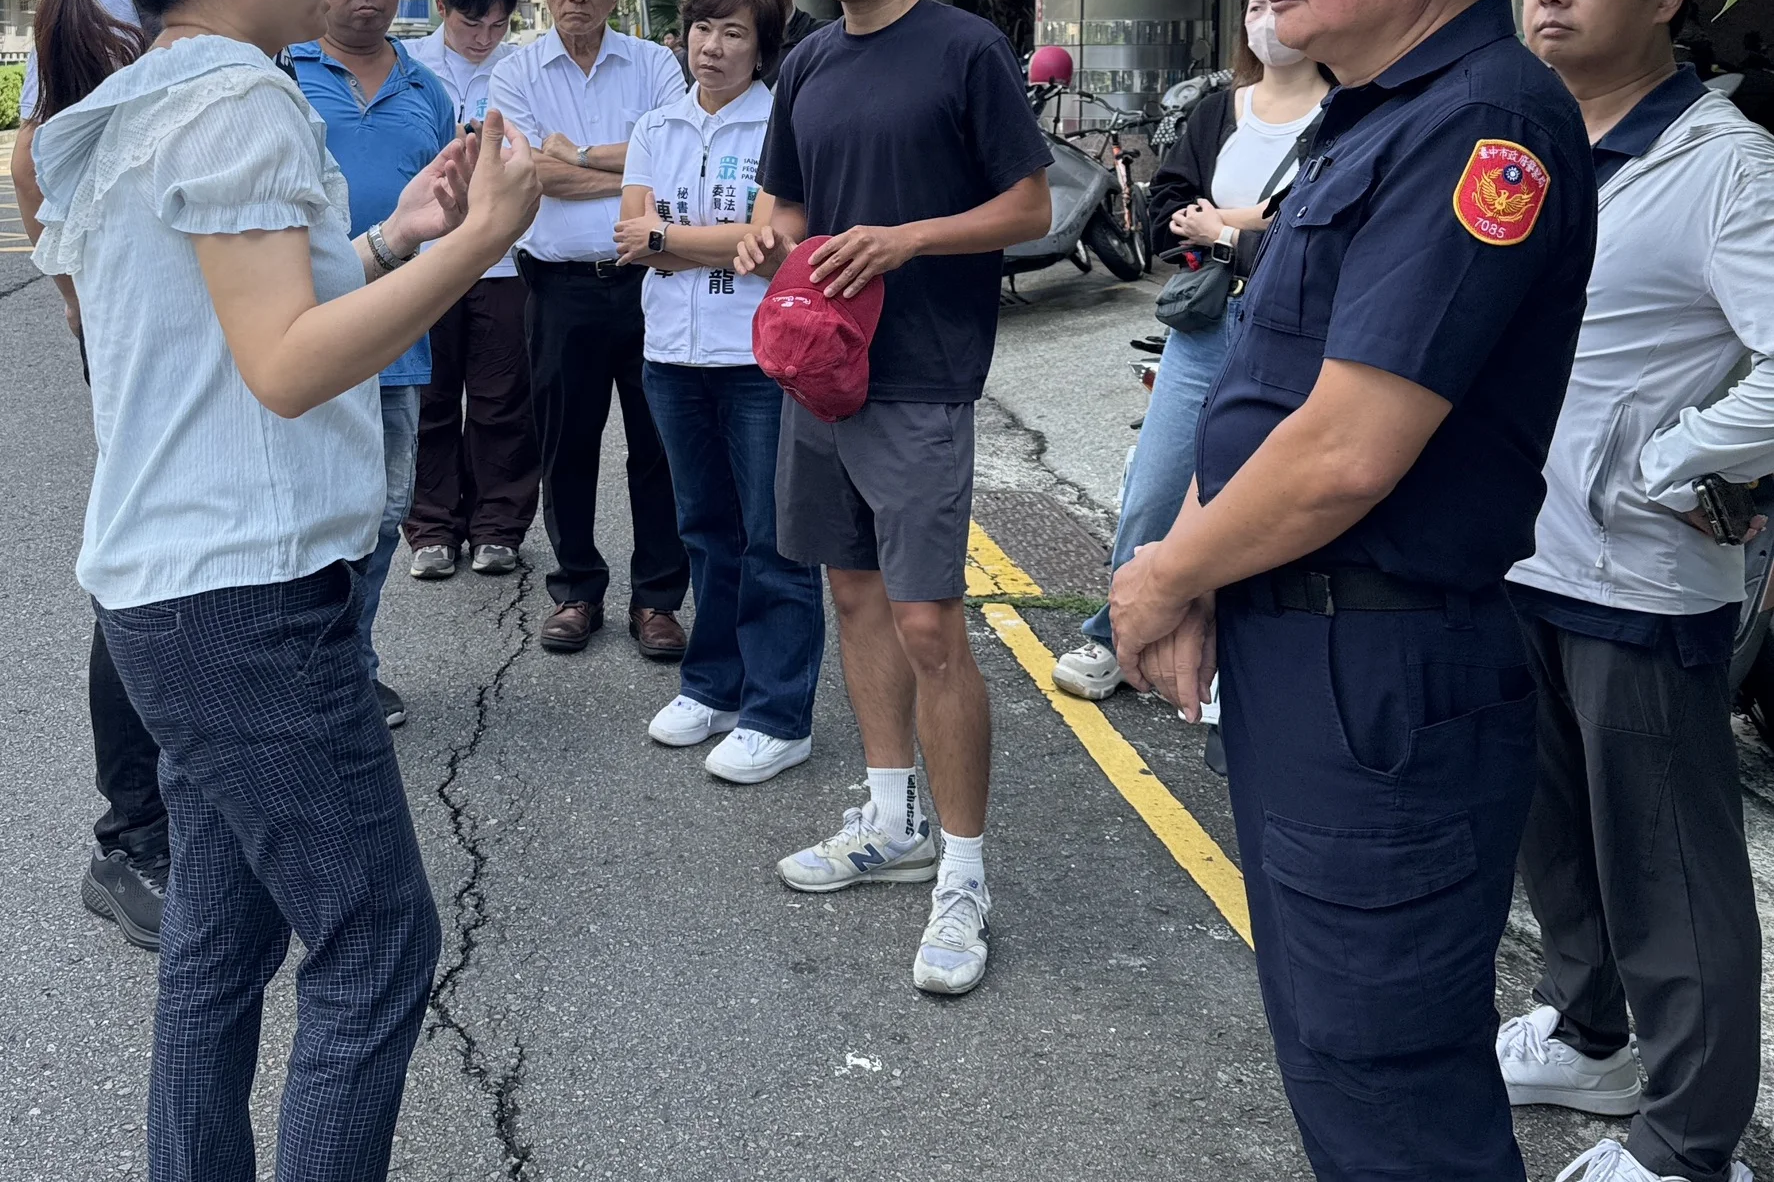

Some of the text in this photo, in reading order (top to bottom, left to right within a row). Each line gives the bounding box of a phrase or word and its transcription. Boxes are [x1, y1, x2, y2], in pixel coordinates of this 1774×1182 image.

[744, 158, 760, 166] TAIW
[676, 186, 692, 226] 秘書長
[1474, 217, 1507, 239] 7085
